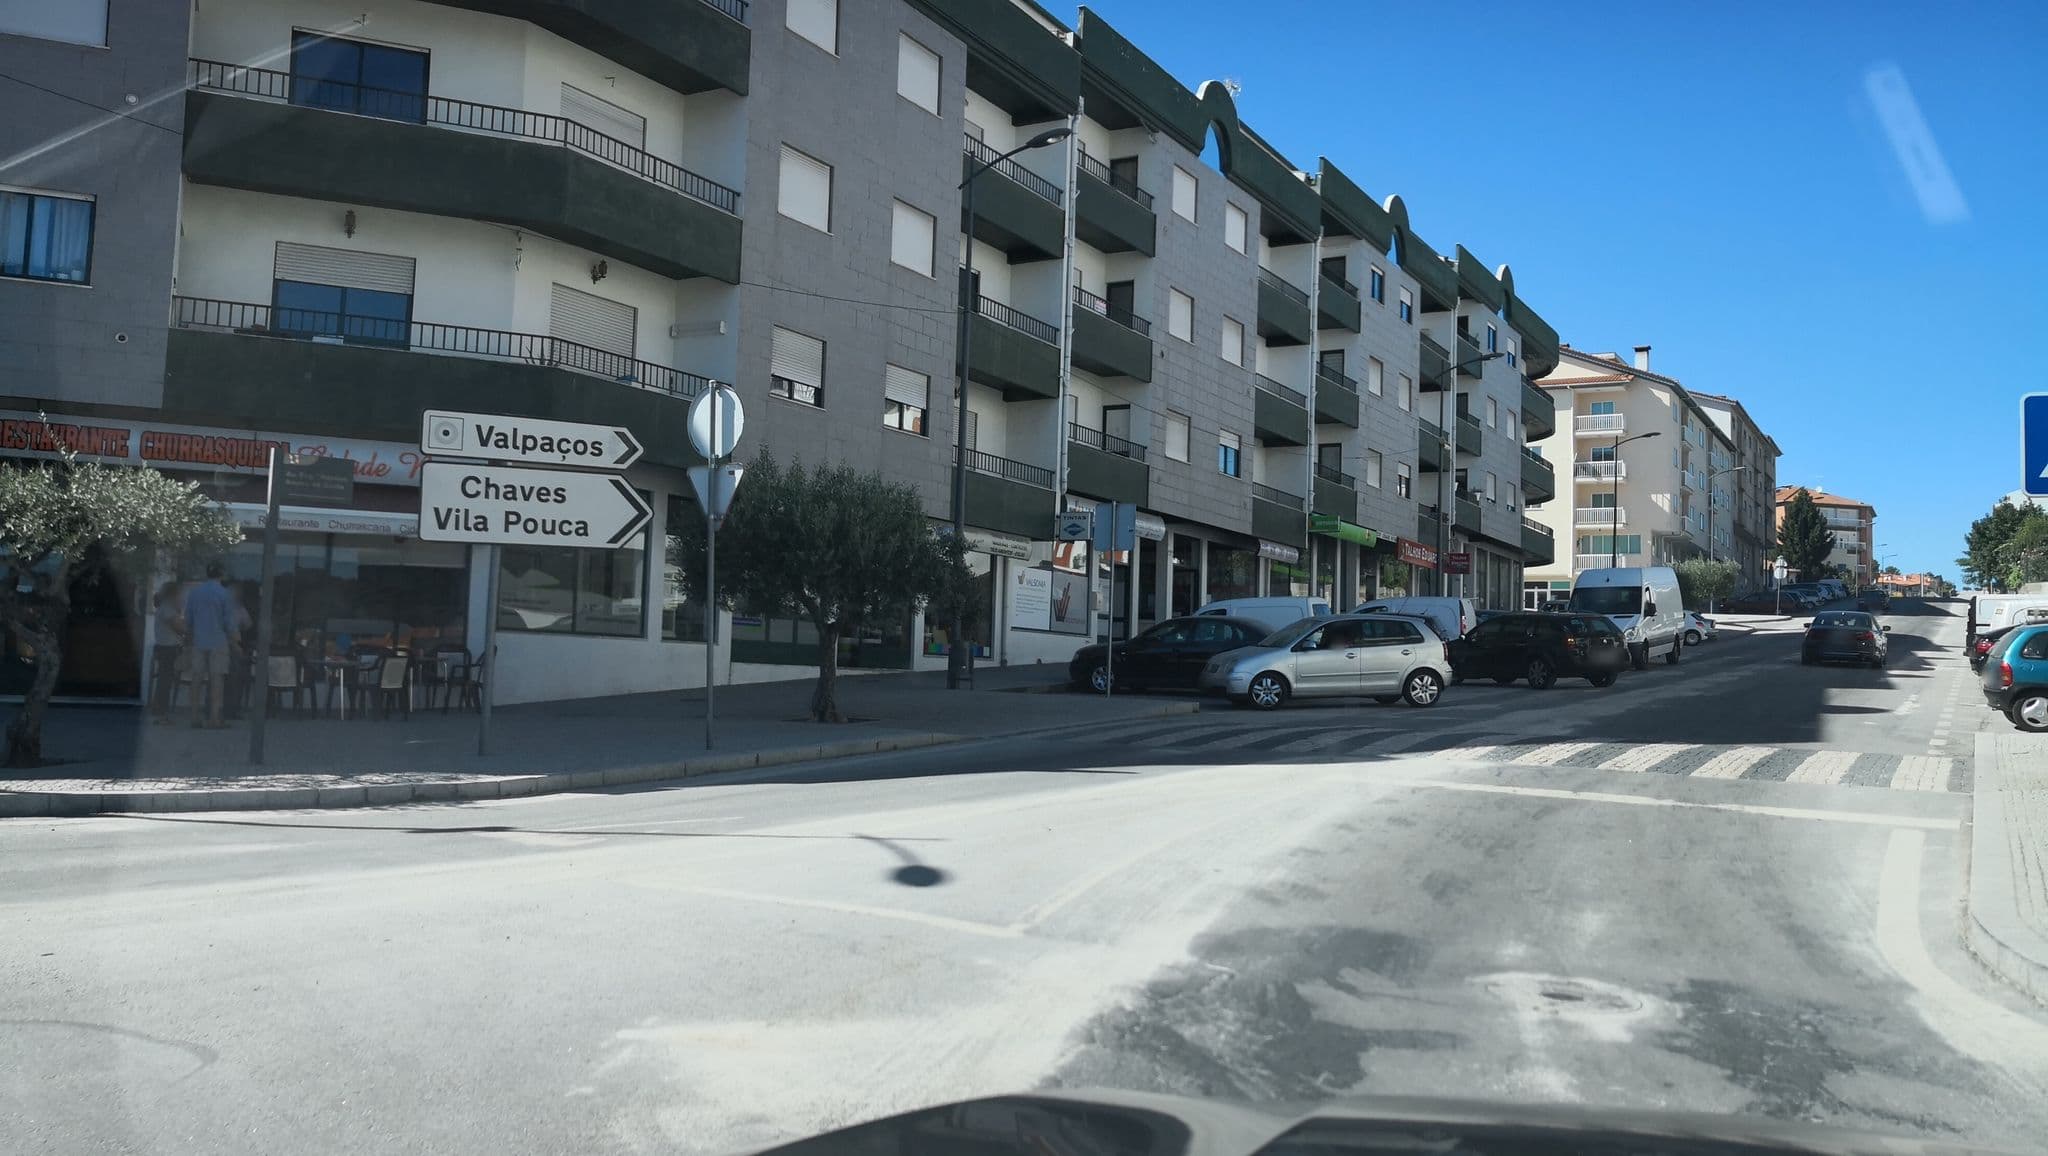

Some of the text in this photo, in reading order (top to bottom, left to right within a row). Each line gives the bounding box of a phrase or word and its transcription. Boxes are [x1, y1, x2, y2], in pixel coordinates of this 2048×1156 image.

[0, 419, 130, 458] ESTAURANTE
[475, 424, 604, 461] Valpaços
[460, 475, 567, 504] Chaves
[257, 515, 320, 529] Rtaurante
[433, 506, 589, 537] Vila Pouca
